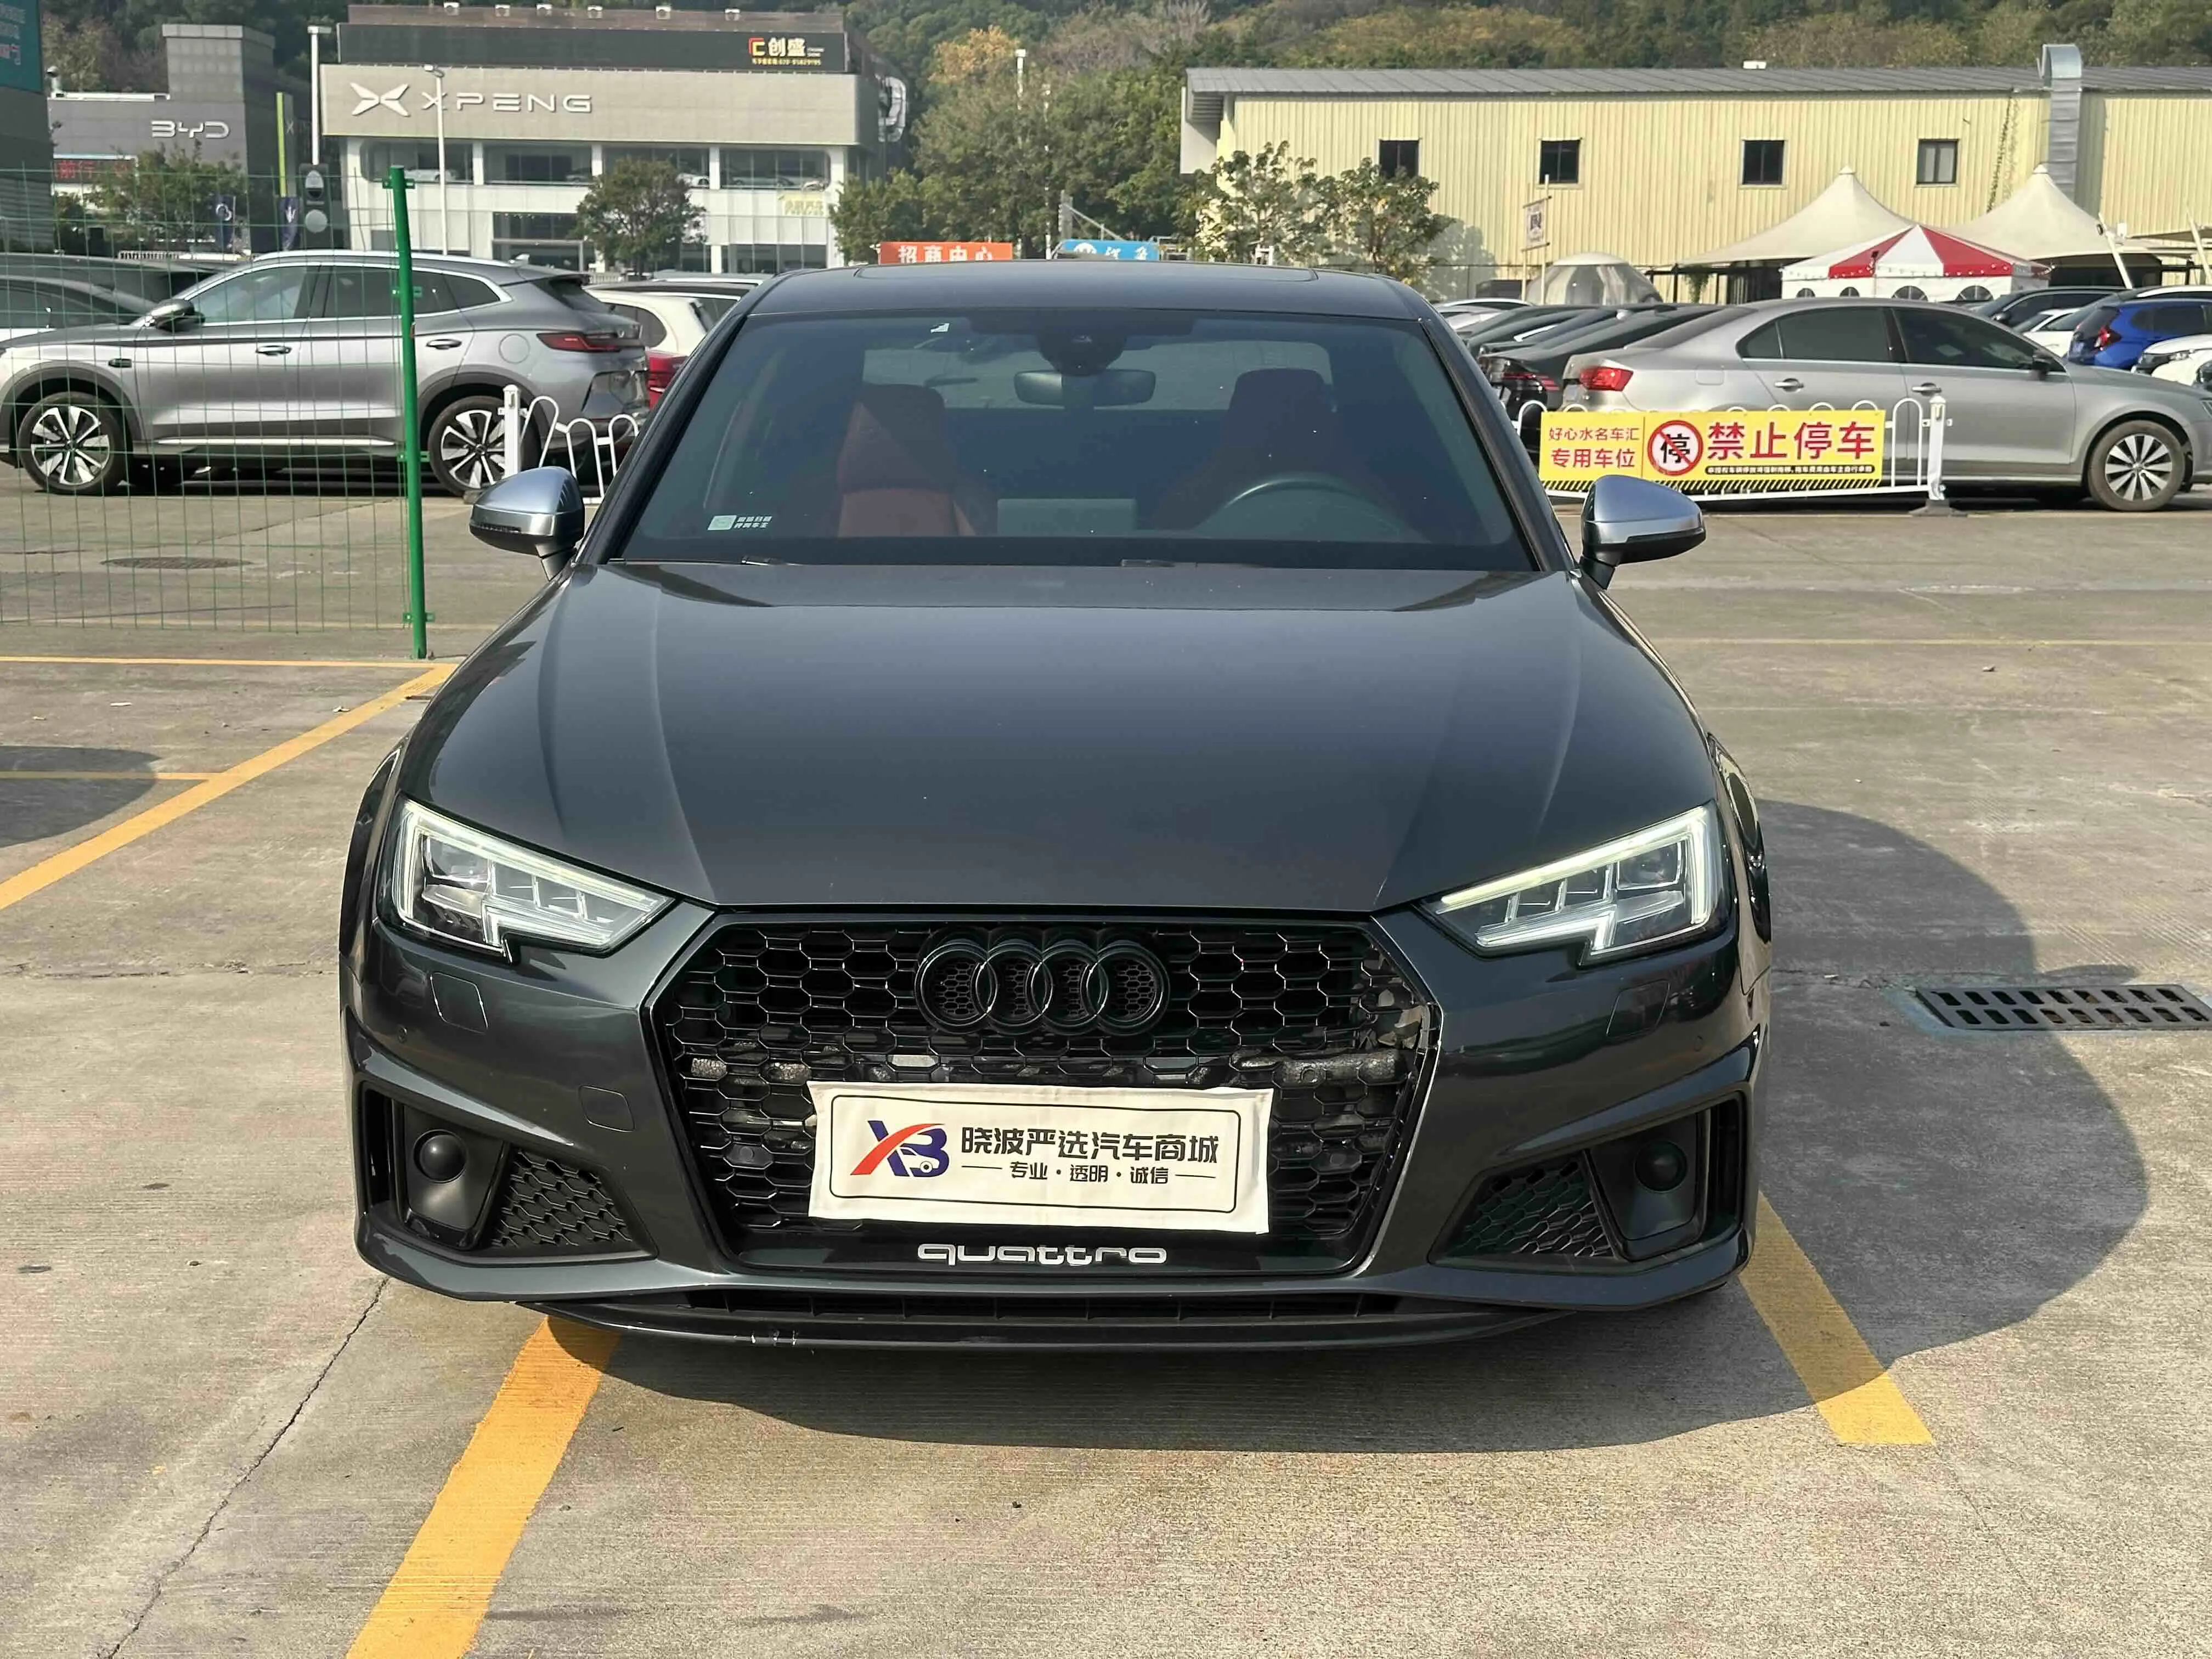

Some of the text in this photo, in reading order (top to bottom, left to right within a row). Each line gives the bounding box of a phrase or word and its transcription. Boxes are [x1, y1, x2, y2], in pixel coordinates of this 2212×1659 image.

[768, 37, 805, 57] 创盛
[421, 92, 592, 113] XPENG
[151, 120, 229, 138] BYD
[898, 245, 993, 263] 招商中心
[1549, 427, 1640, 441] 好心水名车汇
[1707, 421, 1875, 460] 禁止停车
[1551, 448, 1635, 468] 专用车位
[1660, 433, 1690, 464] 停
[961, 1126, 1220, 1164] 晓波严选汽车商城
[917, 1243, 1167, 1266] quattro
